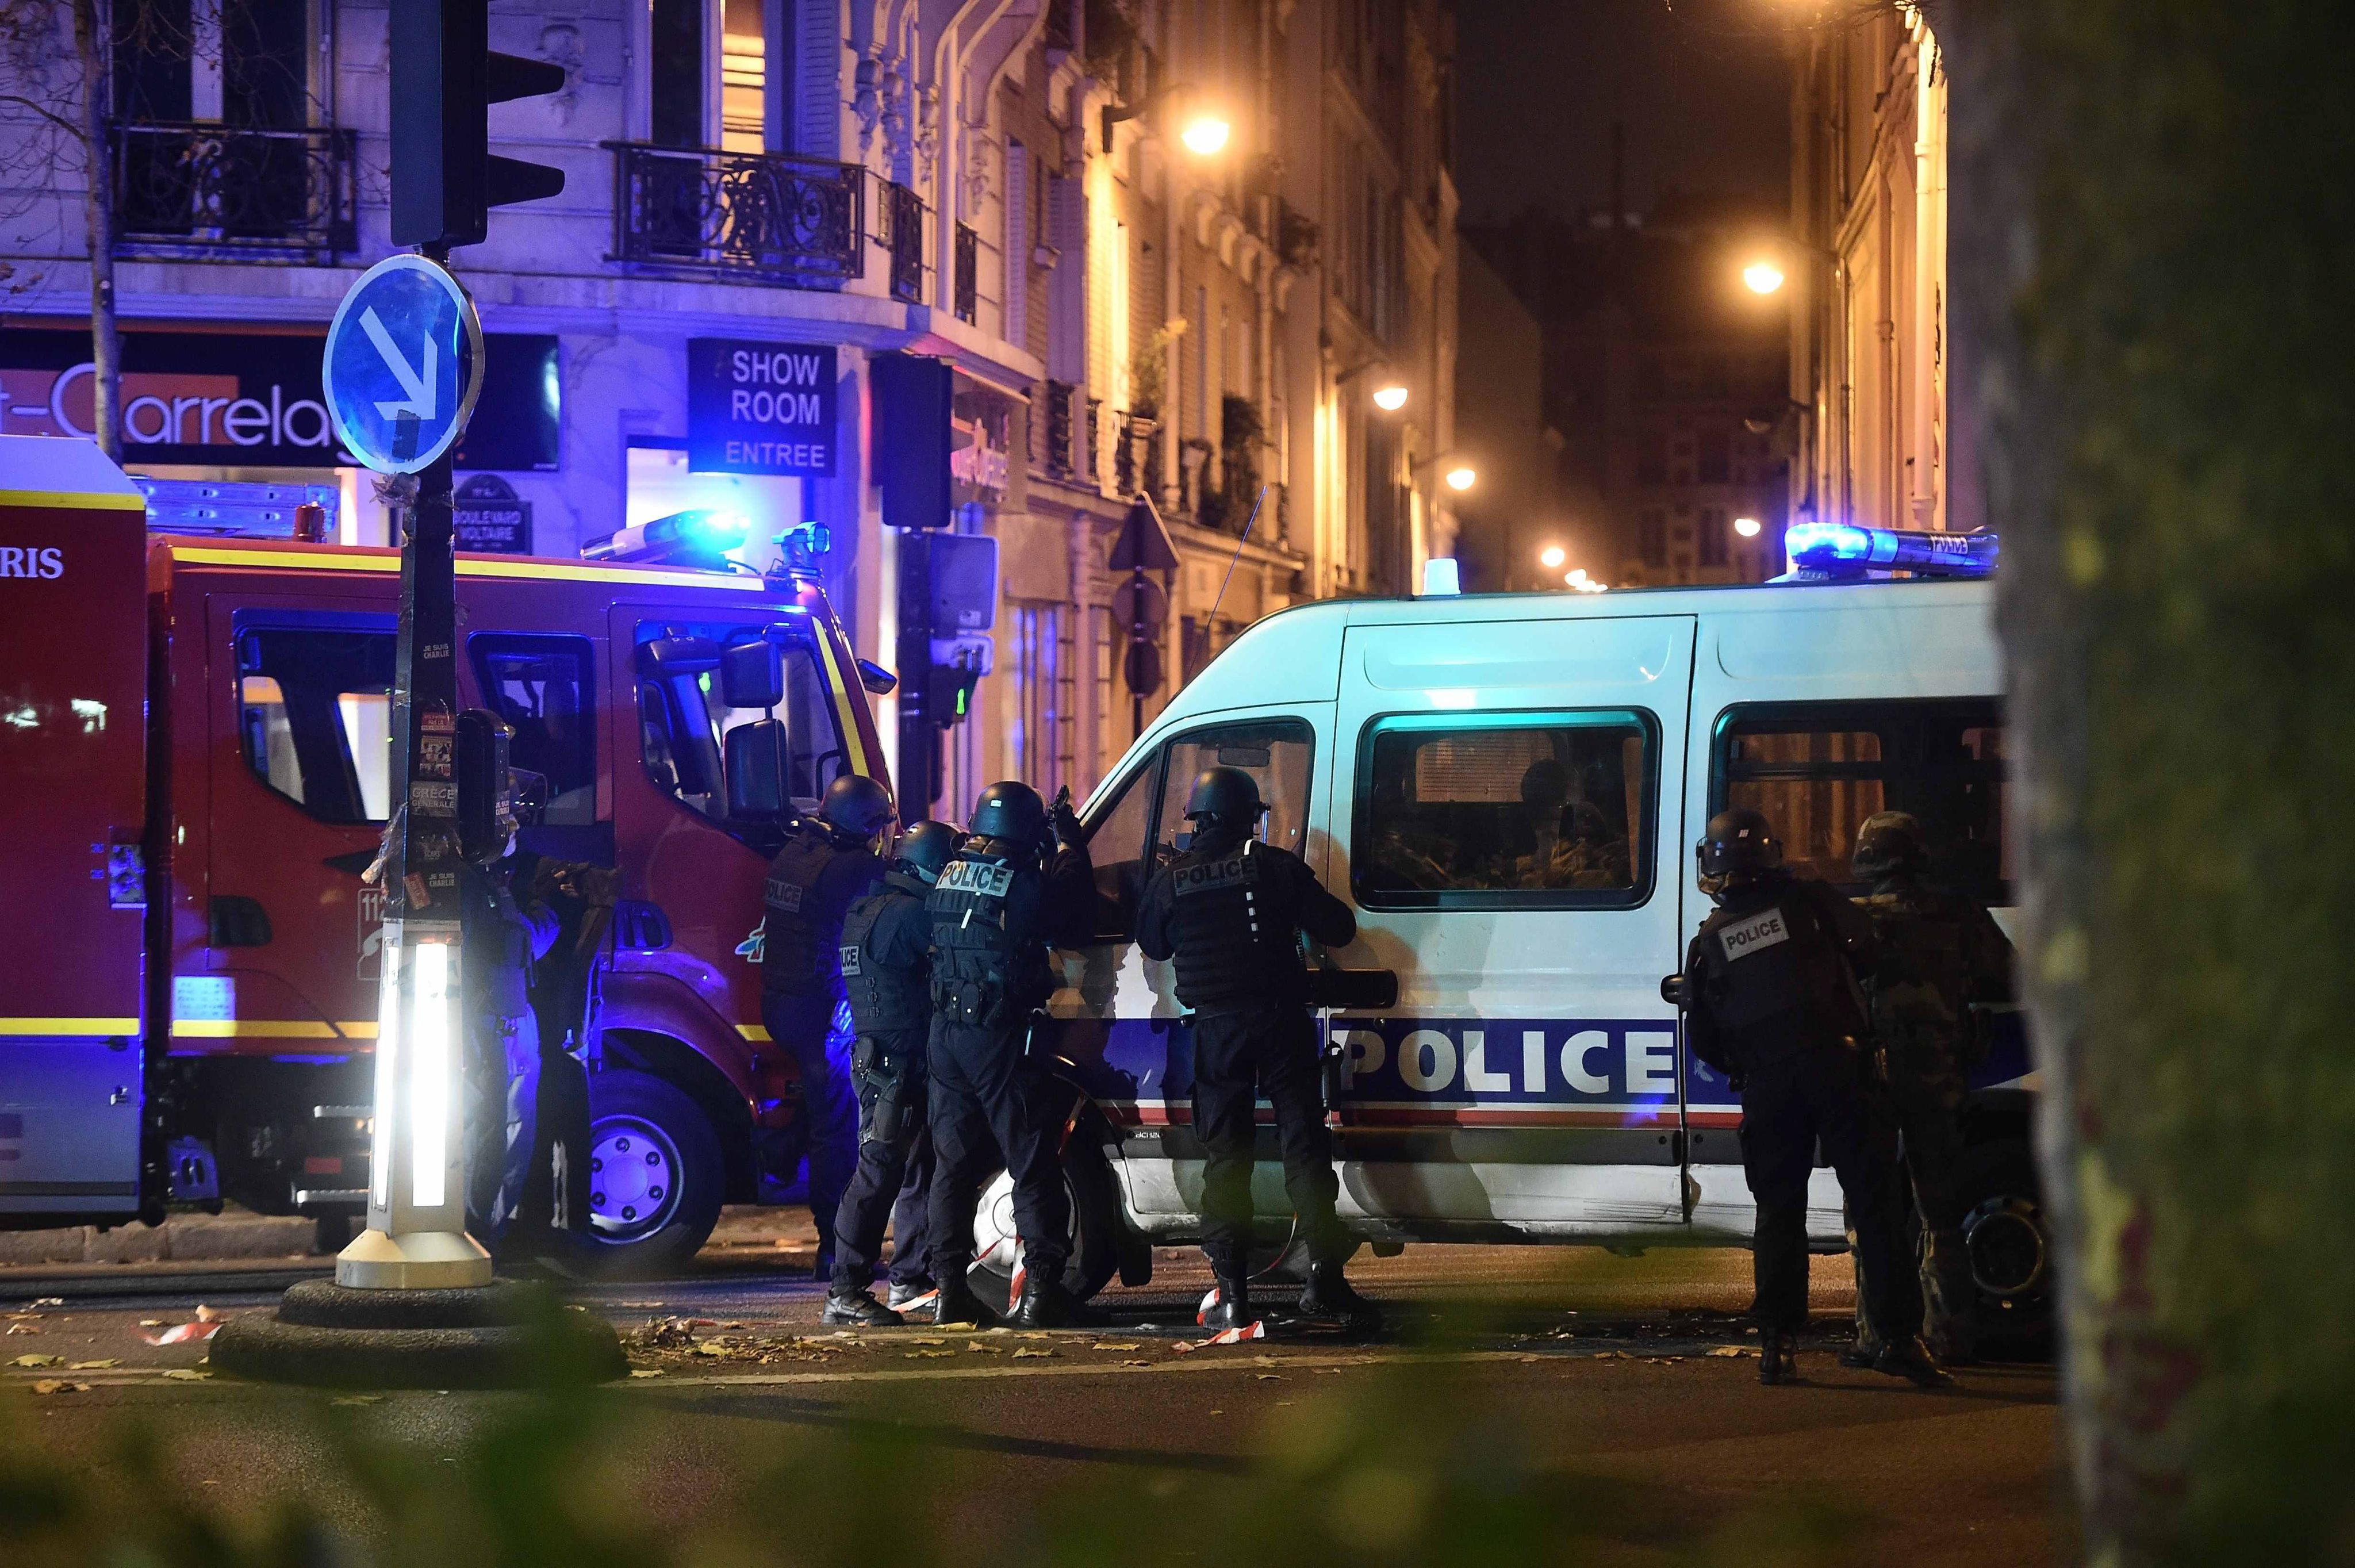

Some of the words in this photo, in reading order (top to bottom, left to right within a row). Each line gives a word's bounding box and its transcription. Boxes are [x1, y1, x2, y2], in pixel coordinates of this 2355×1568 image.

[732, 350, 820, 386] SHOW
[731, 389, 820, 425] ROOM
[726, 441, 826, 467] ENTREE
[0, 547, 64, 579] RIS
[939, 864, 1006, 892] POLICE
[1176, 856, 1255, 889] POLICE
[1726, 918, 1781, 950] POLICE
[1331, 1029, 1675, 1094] POLICE
